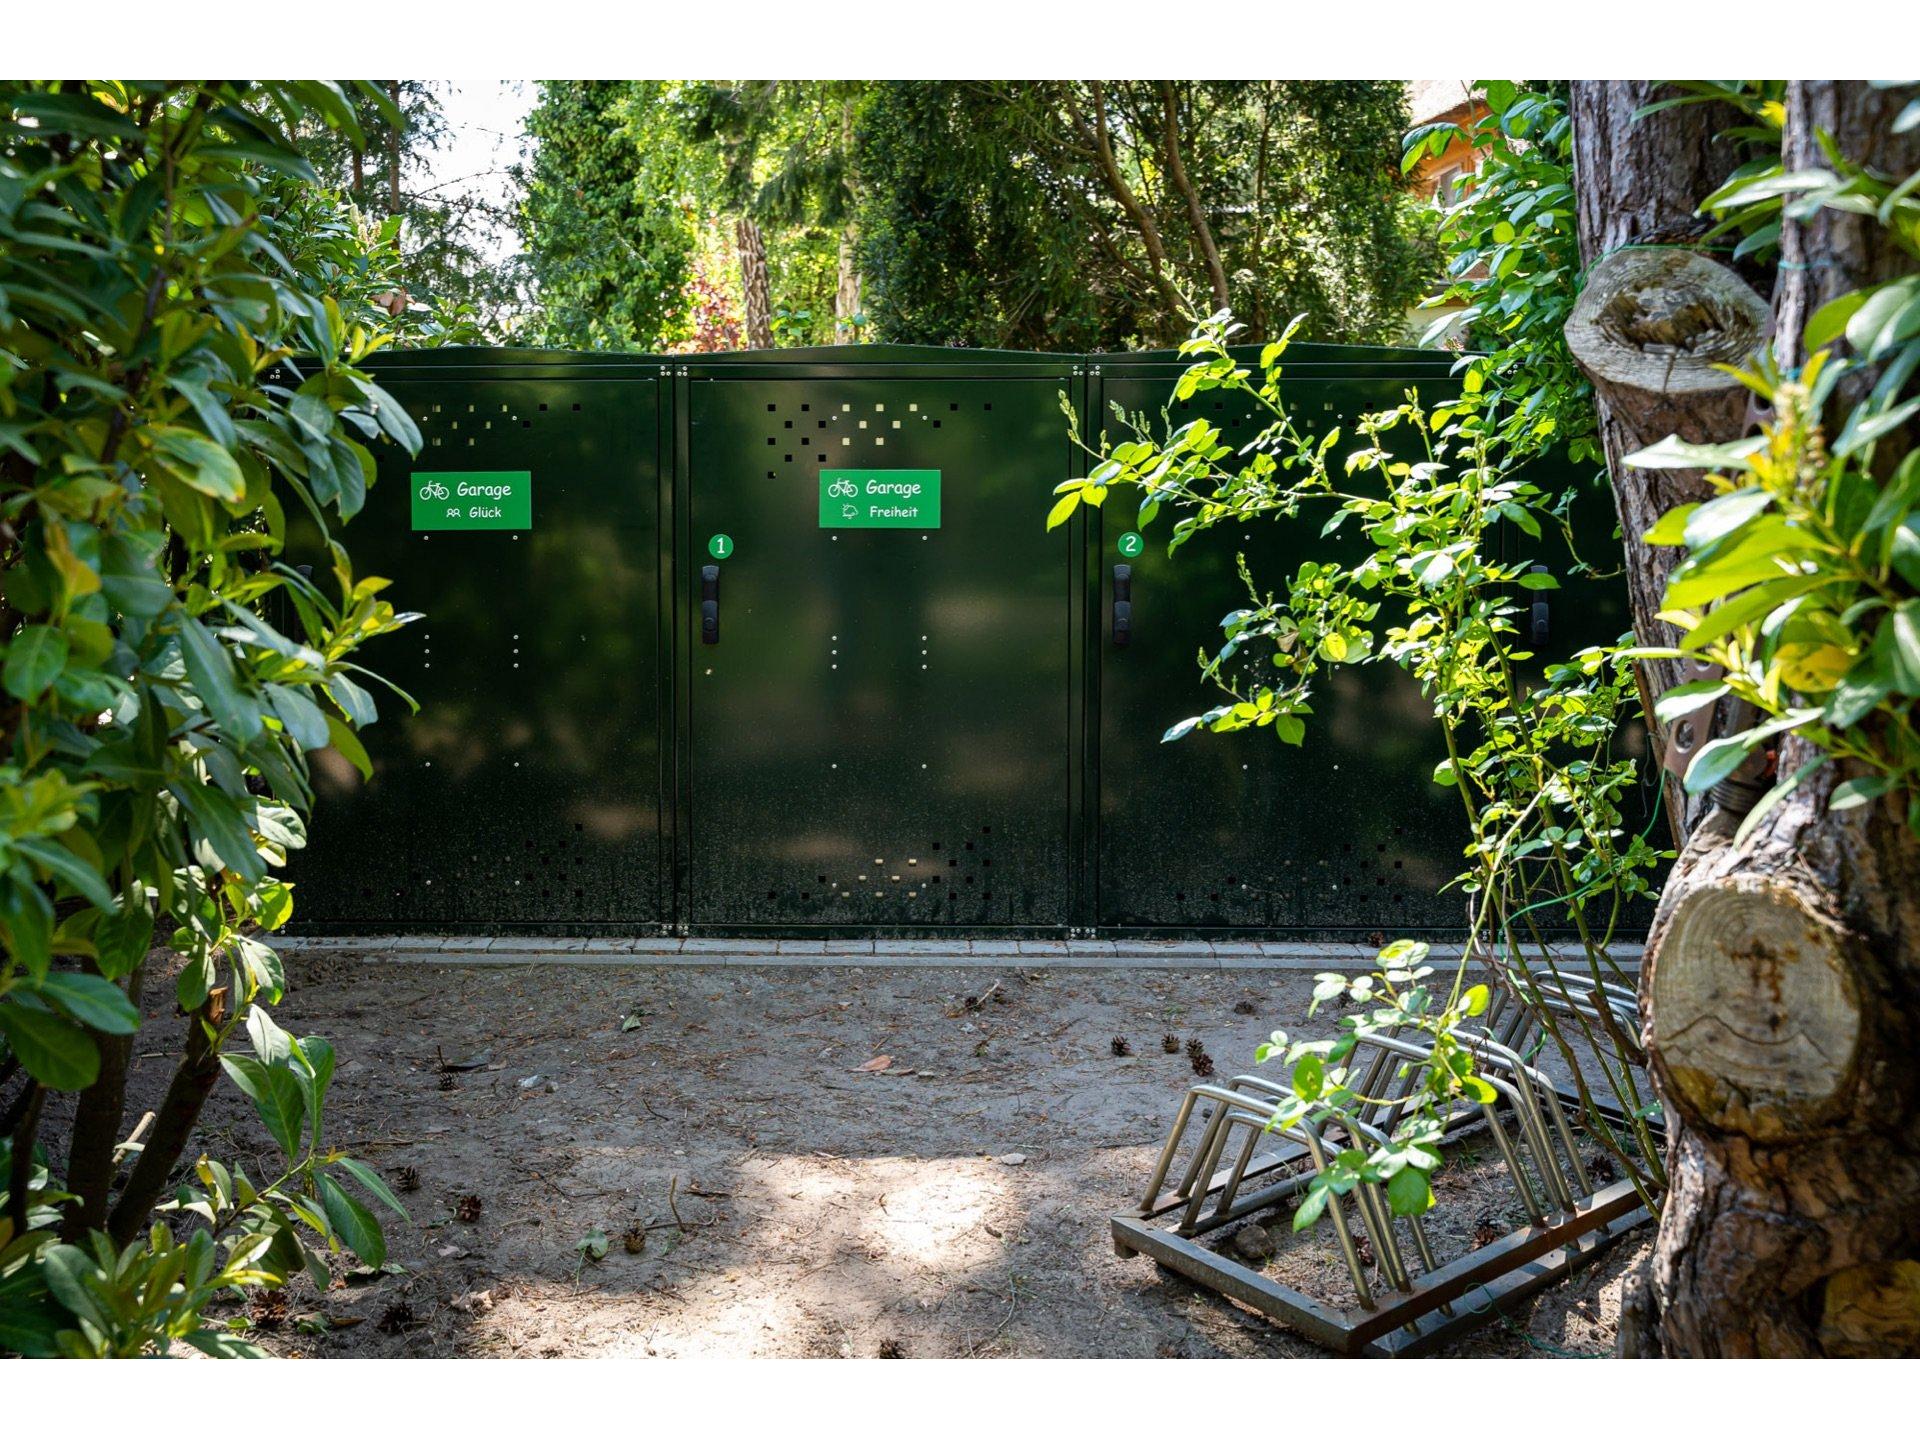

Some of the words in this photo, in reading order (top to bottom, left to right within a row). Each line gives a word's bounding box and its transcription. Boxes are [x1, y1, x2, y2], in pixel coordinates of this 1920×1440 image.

[457, 481, 512, 500] Garage
[866, 479, 922, 499] Garage
[469, 506, 502, 518] Glück
[869, 505, 919, 518] Freiheit
[717, 537, 726, 554] 1
[1125, 535, 1137, 552] 2
